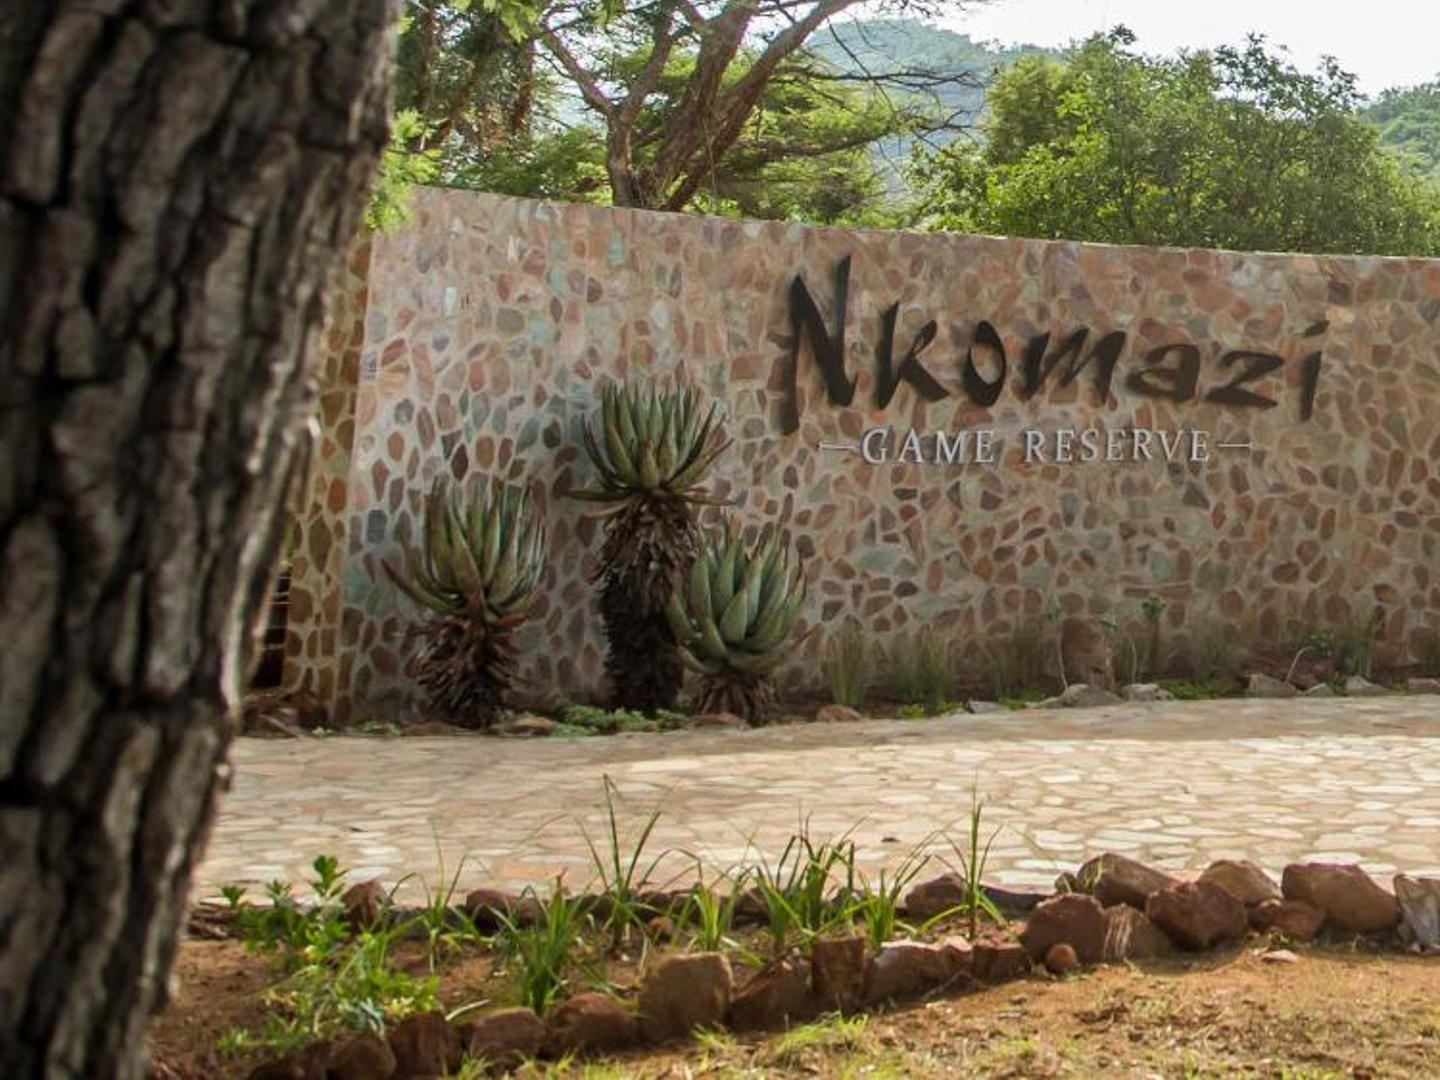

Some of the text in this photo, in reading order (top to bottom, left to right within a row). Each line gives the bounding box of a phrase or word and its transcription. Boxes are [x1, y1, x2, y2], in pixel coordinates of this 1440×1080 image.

[780, 254, 1328, 436] Nkomazi
[861, 428, 1210, 464] GAME RESERVE
